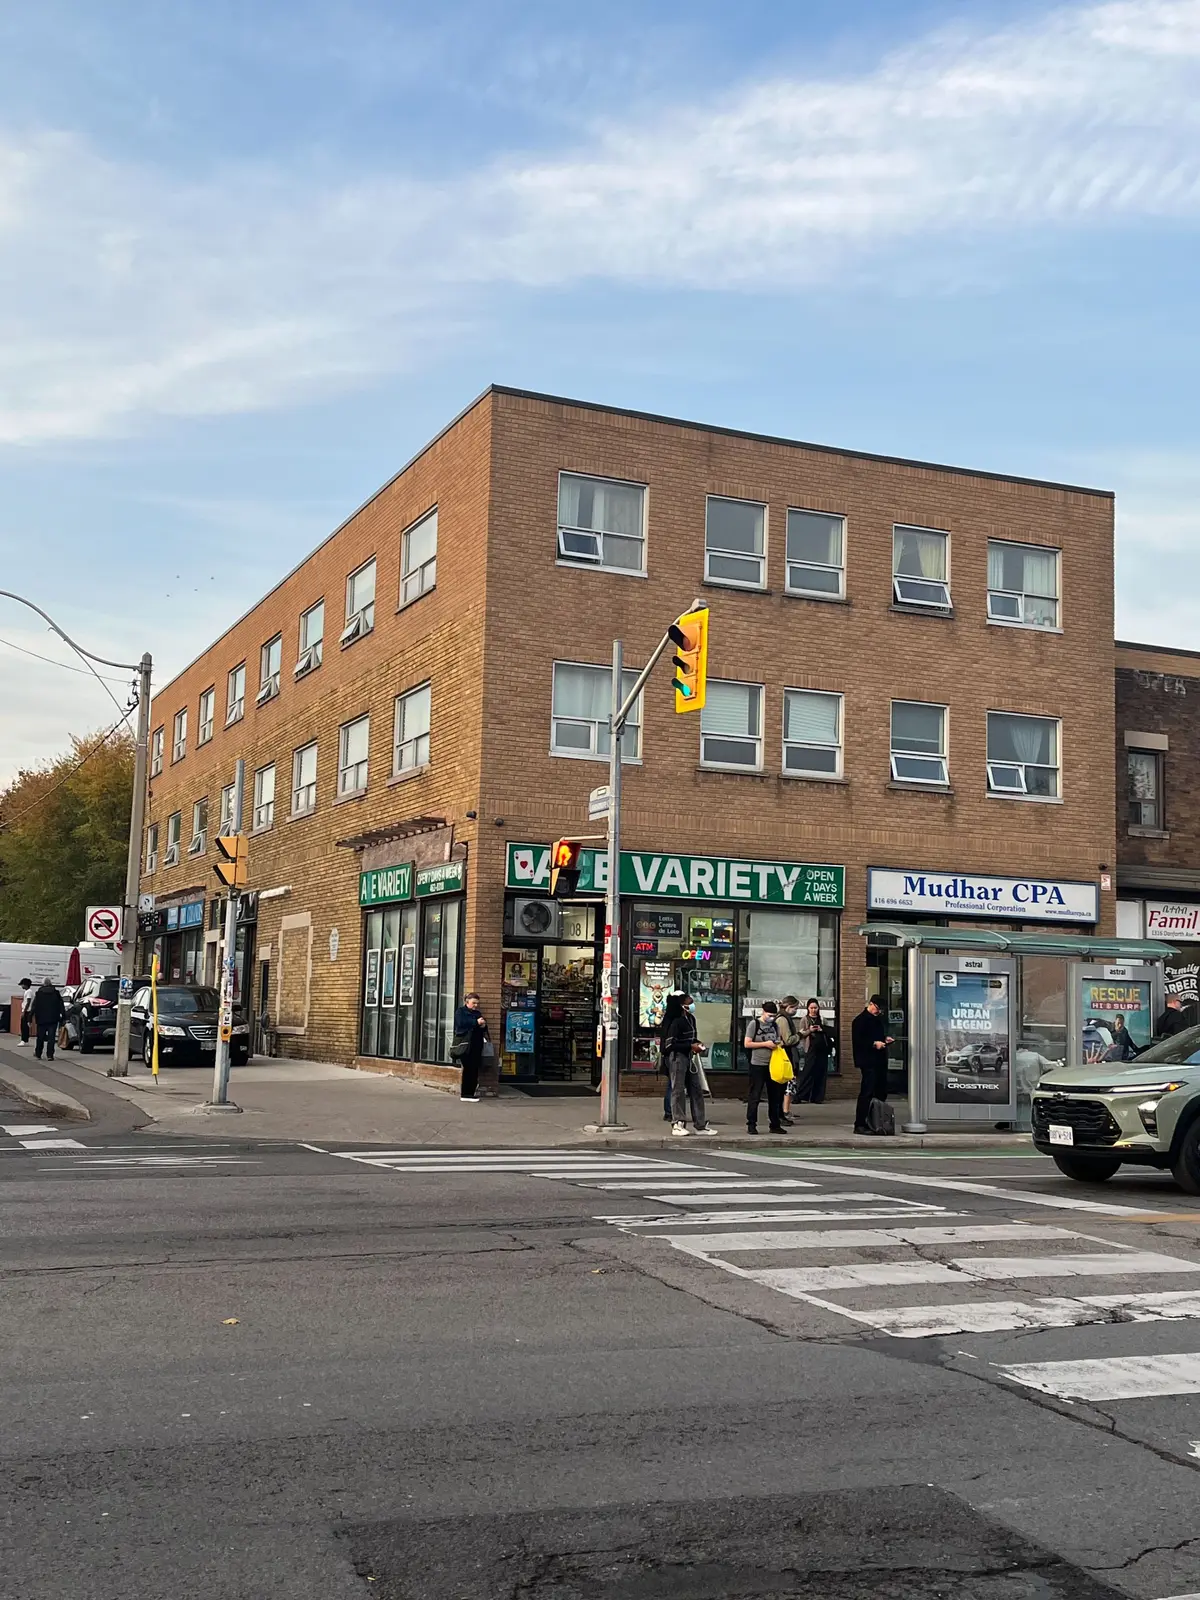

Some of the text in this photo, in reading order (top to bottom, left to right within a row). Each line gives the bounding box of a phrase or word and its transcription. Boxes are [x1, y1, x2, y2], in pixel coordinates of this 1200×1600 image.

[532, 850, 801, 901] AE VARIETY
[806, 870, 834, 882] OPEN
[377, 867, 410, 898] VARIETY
[804, 882, 838, 893] 7 DAYS
[903, 875, 1066, 905] Mudhar CPA
[804, 892, 838, 903] A WEEK
[945, 900, 1026, 913] Professional Corporation
[1148, 910, 1200, 935] Famil
[635, 942, 654, 951] ATM
[682, 949, 711, 960] OPEN
[964, 960, 982, 968] astral
[1165, 963, 1200, 975] Family
[1090, 987, 1140, 1002] RESCUE
[952, 1008, 990, 1019] URBAN
[951, 1019, 992, 1030] LEGEND
